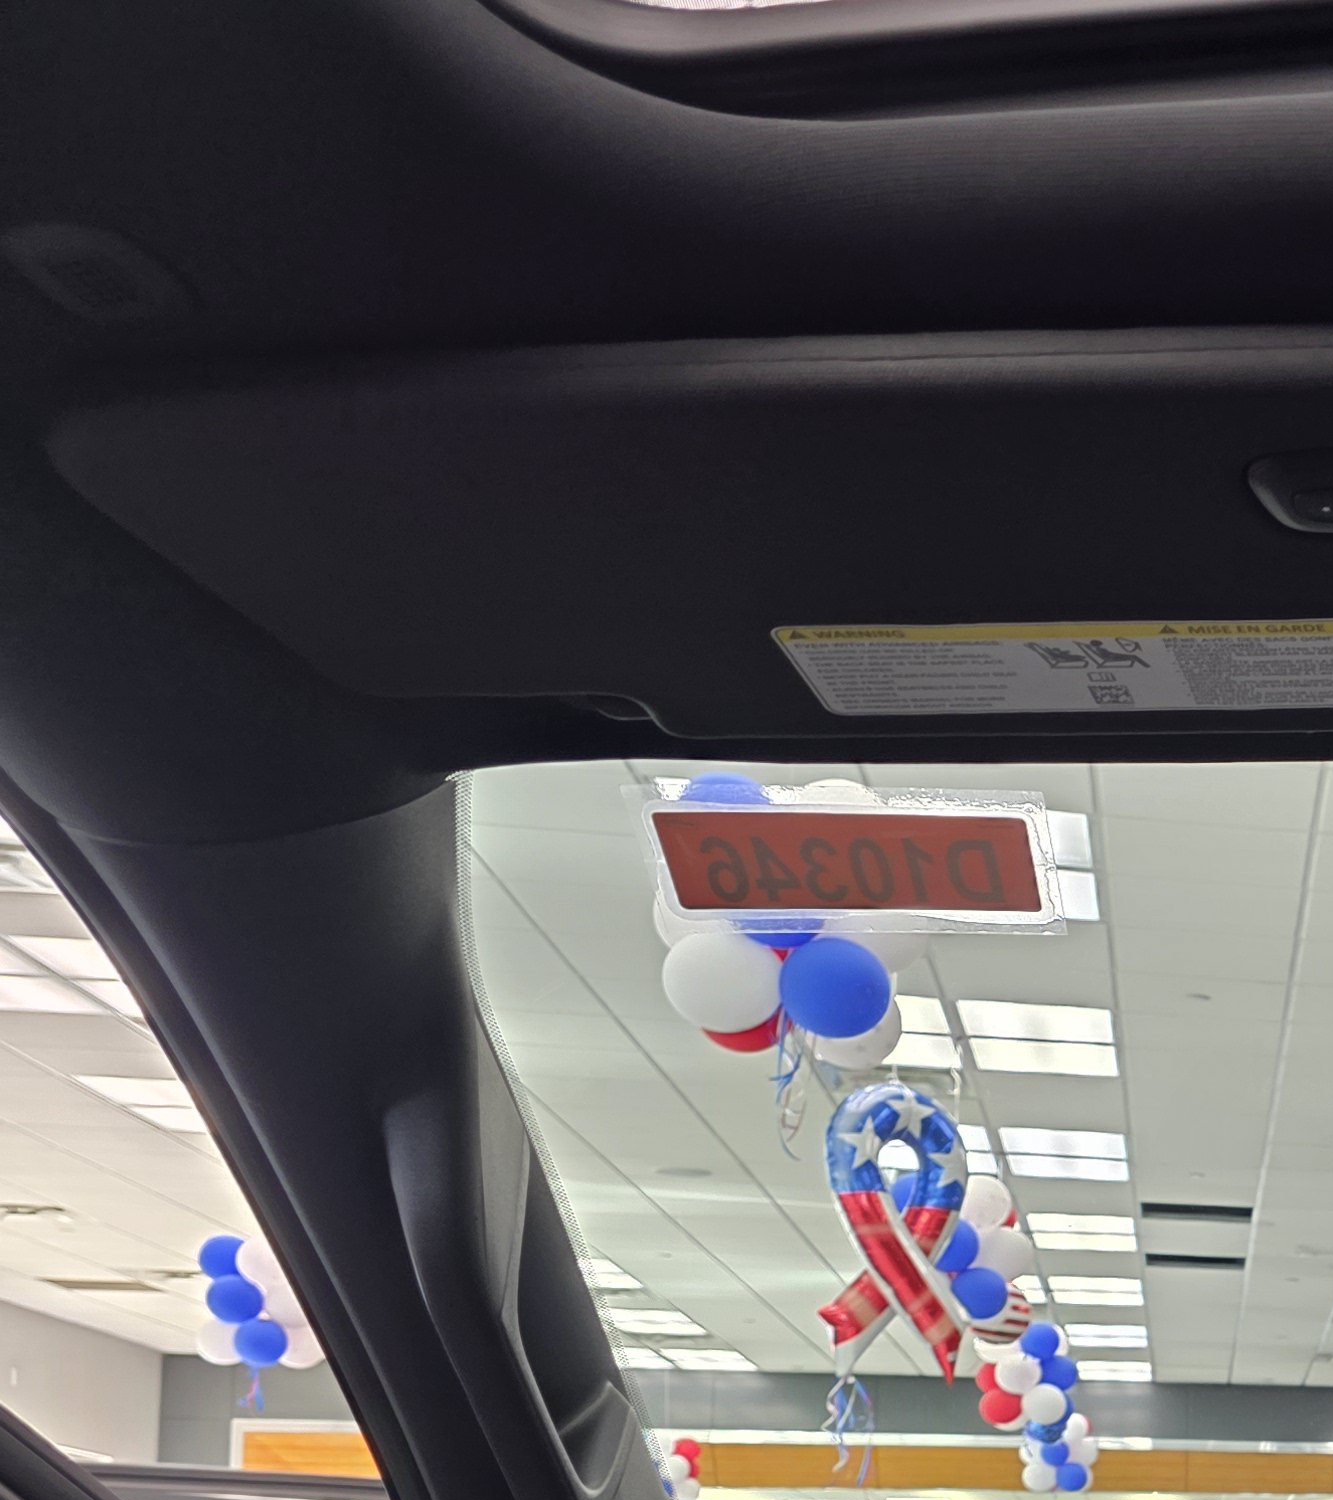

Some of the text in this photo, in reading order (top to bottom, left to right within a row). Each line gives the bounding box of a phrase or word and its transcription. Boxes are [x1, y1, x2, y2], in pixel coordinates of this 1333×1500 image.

[813, 629, 905, 639] WARNING
[1187, 623, 1326, 635] MISE EN GARDE
